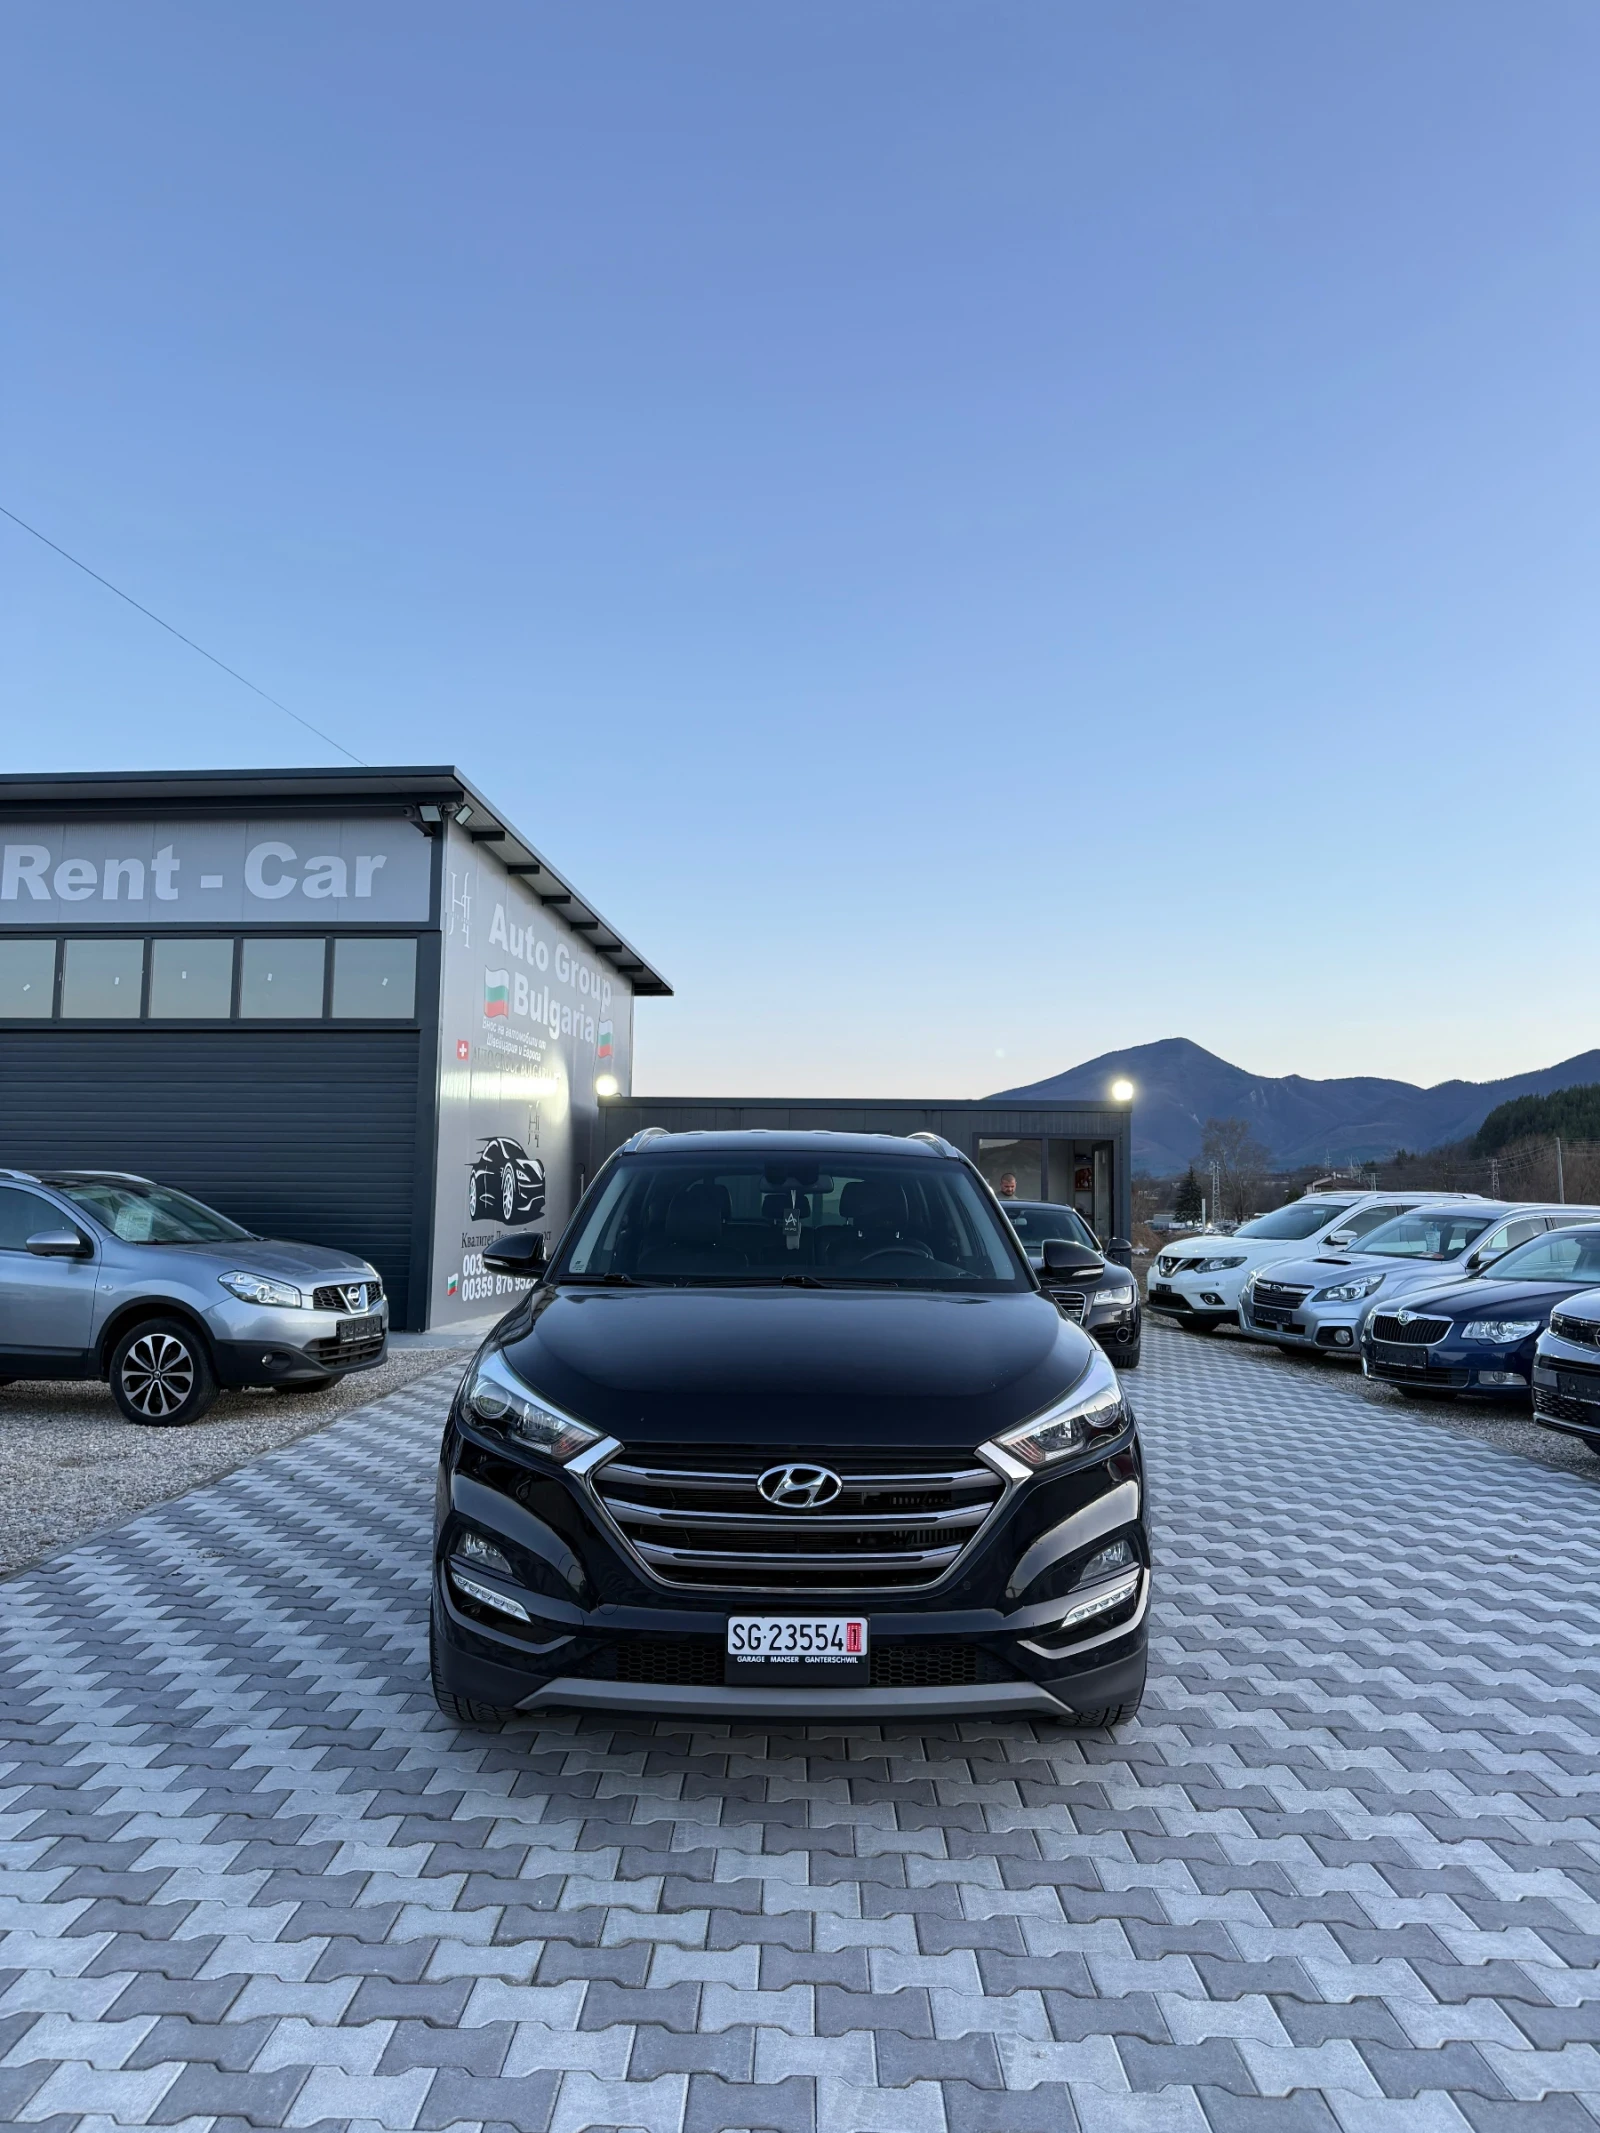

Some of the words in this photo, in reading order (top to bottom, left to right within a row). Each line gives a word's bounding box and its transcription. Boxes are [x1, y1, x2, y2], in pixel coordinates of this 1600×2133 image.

[1, 844, 181, 901] Rent
[200, 875, 223, 889] -
[244, 841, 388, 900] Car
[488, 903, 549, 972] Auto
[555, 943, 612, 1013] Group
[513, 972, 595, 1043] Bulgaria
[462, 1275, 493, 1301] 00359
[496, 1275, 513, 1295] 876
[736, 1655, 765, 1663] GARAGE
[804, 1656, 858, 1664] GANTERSCHWIL
